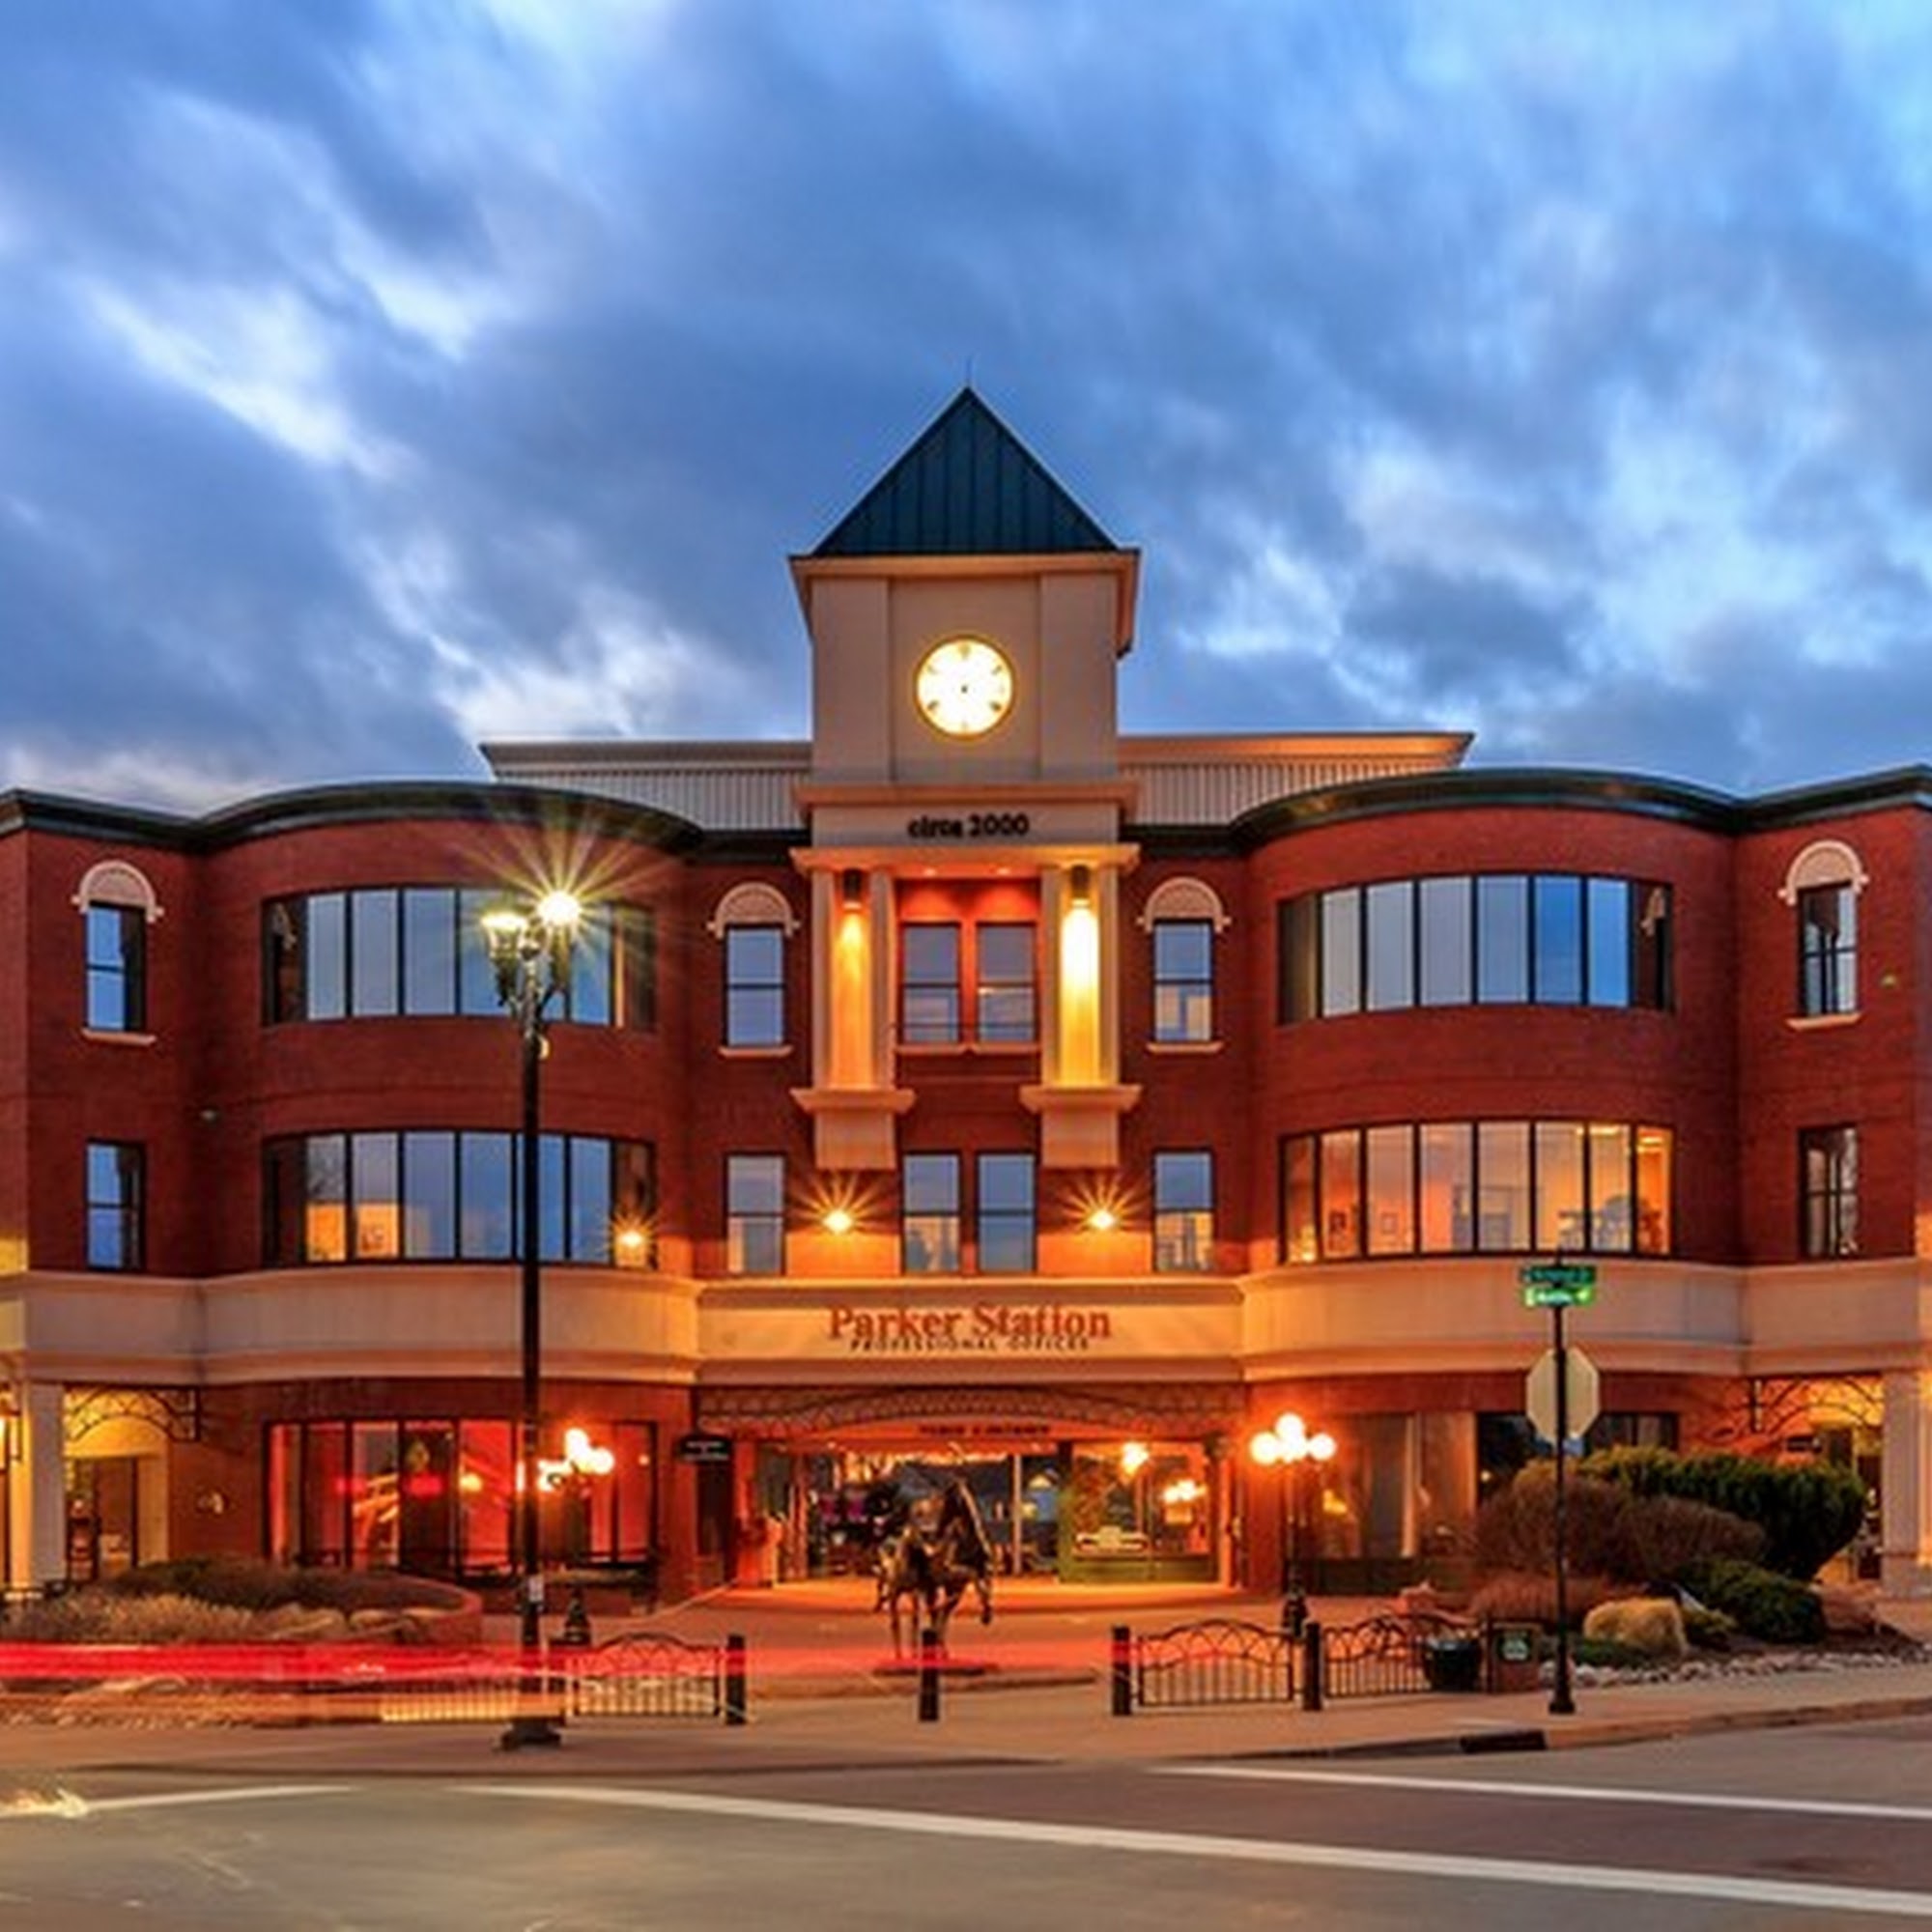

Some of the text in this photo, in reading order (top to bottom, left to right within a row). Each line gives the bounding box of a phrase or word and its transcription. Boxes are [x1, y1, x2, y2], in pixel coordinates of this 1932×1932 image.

[907, 812, 1030, 838] circa 2000
[829, 1300, 1111, 1340] Parker Station
